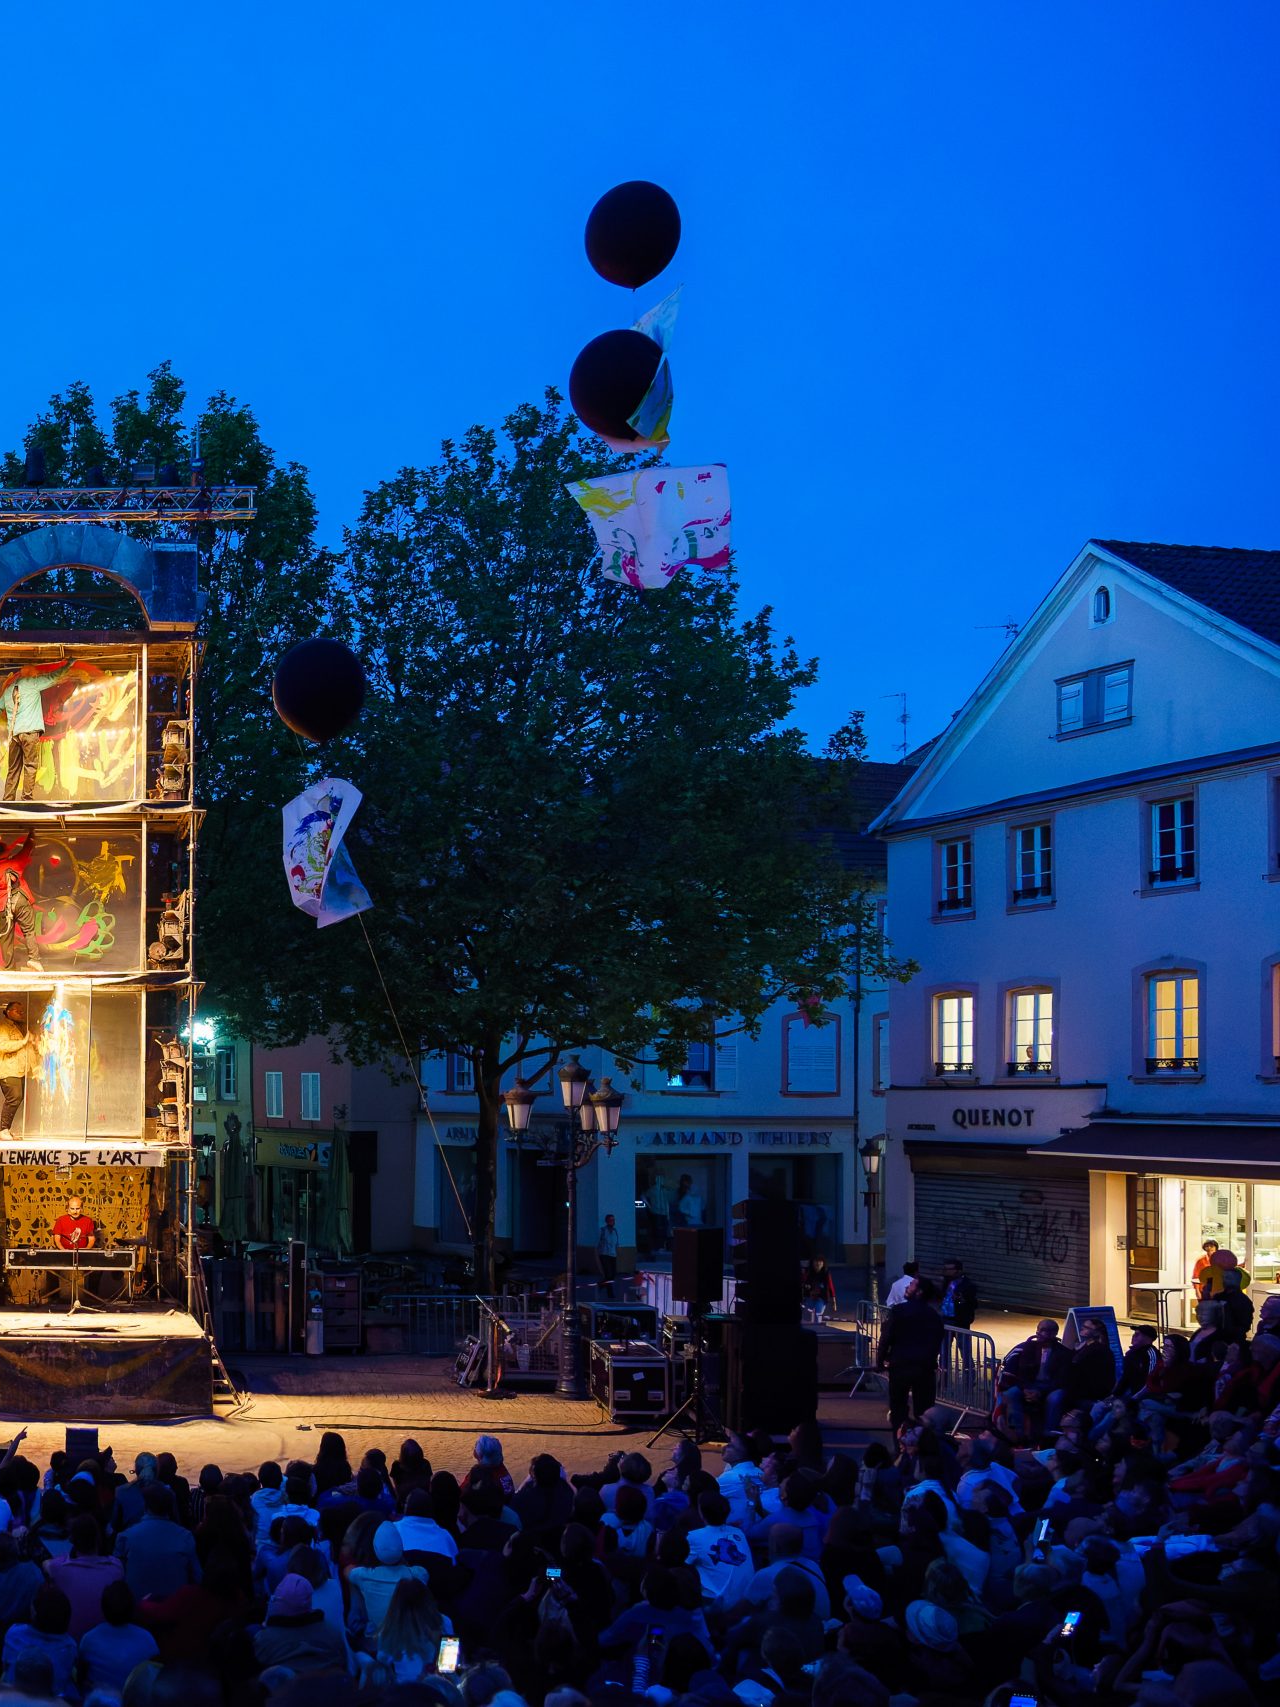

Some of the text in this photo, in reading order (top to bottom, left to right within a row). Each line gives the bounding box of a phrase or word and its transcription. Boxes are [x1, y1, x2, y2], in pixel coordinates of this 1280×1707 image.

[952, 1108, 1035, 1128] QUENOT
[652, 1131, 744, 1145] ARMAND
[0, 1150, 150, 1165] L'ENFANCE DE L'ART
